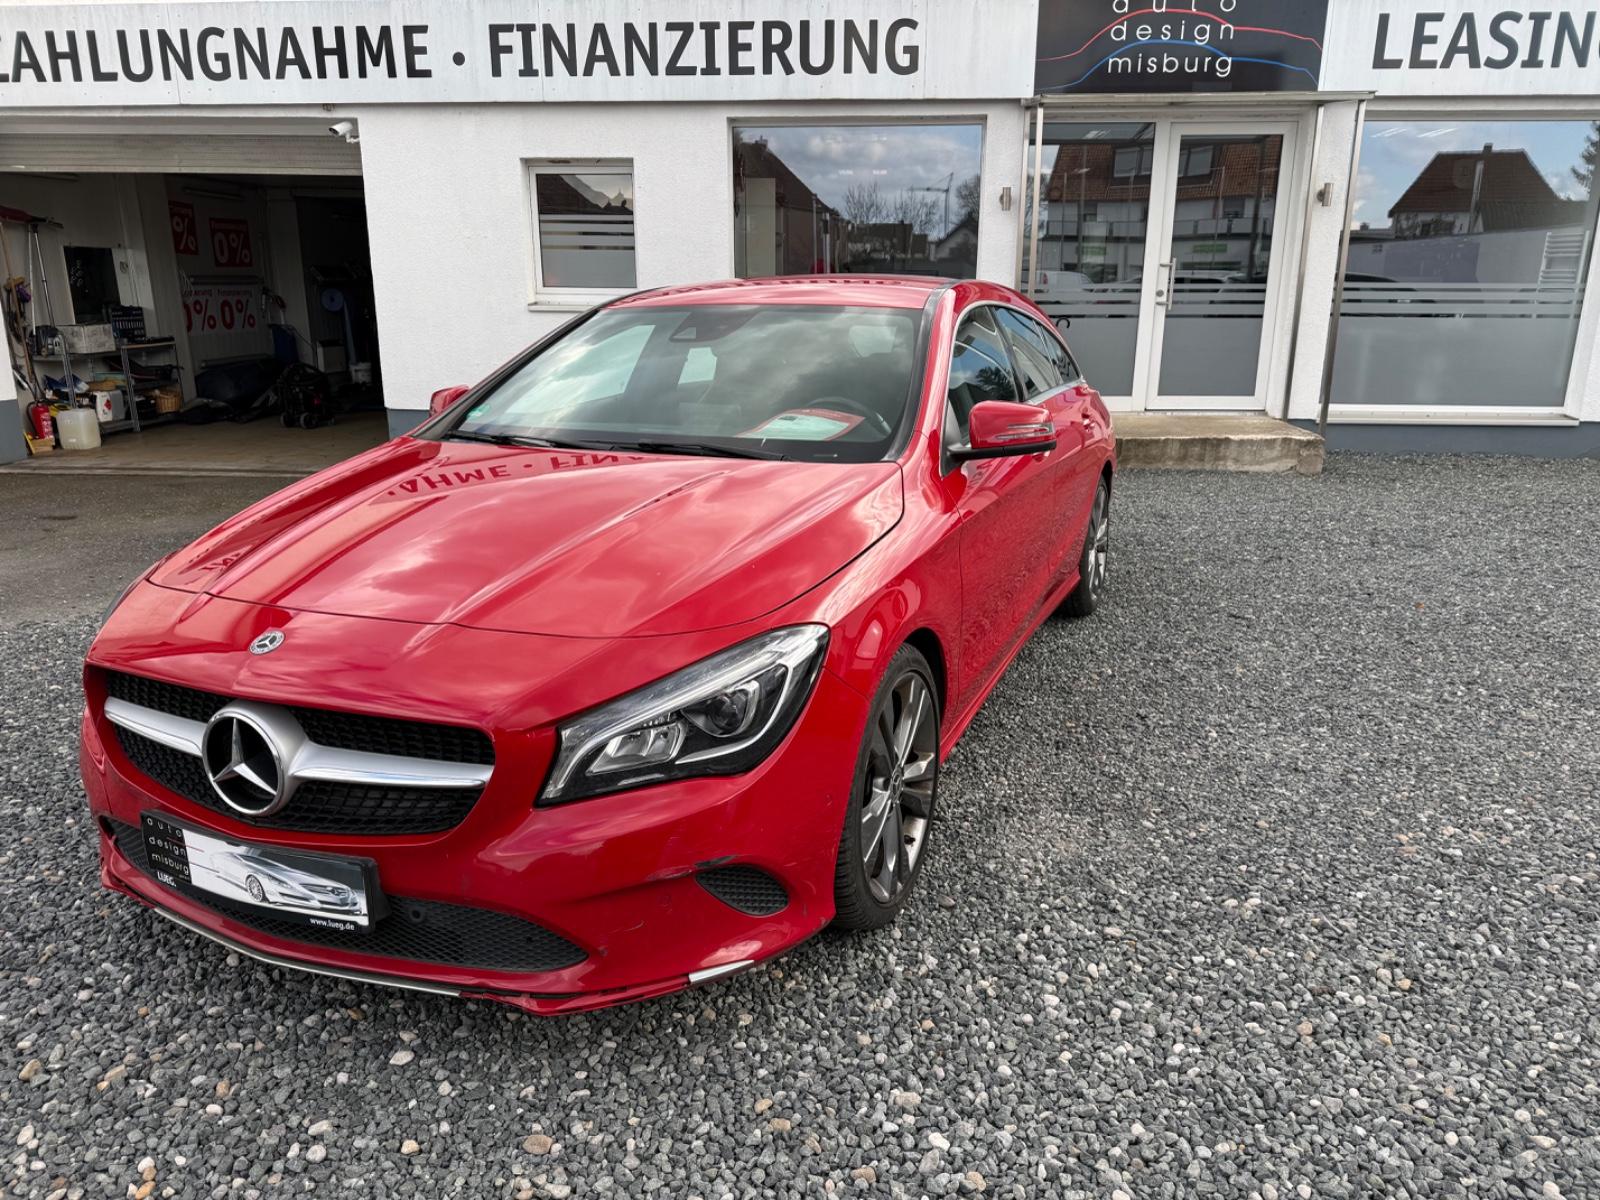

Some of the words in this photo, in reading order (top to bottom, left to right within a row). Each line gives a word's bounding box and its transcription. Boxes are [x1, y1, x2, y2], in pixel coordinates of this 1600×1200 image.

[1110, 20, 1235, 44] design
[1372, 10, 1600, 70] LEASIN
[488, 17, 919, 77] FINANZIERUNG
[1107, 53, 1232, 77] misburg
[213, 231, 251, 264] 0%
[220, 299, 256, 330] 0%
[147, 816, 183, 838] auto
[148, 835, 187, 857] design
[151, 852, 190, 876] misburg
[309, 917, 355, 932] www.lueg.de
